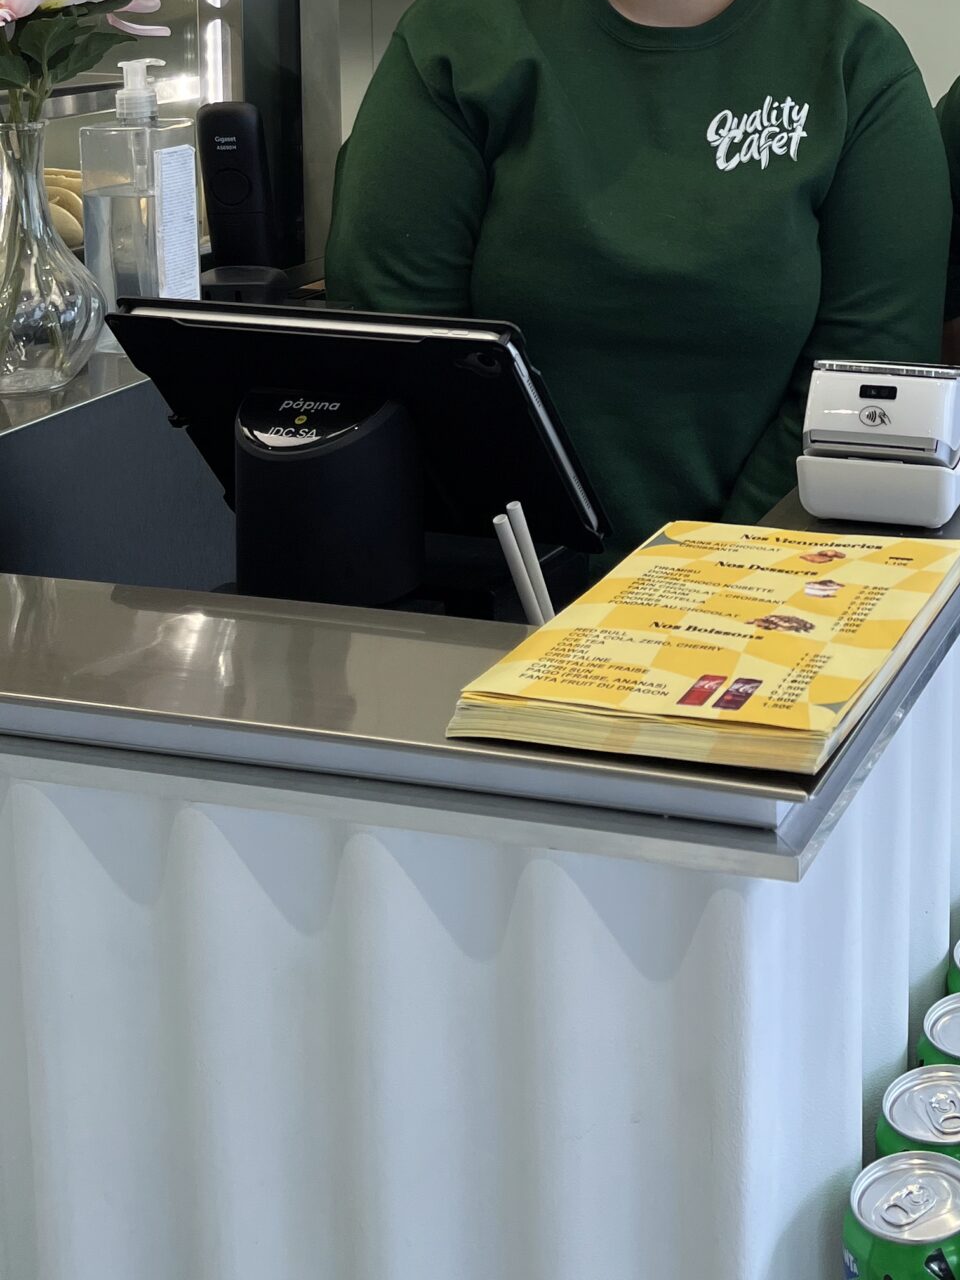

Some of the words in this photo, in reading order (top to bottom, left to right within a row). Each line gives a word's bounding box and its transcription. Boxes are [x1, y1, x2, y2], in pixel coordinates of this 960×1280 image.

[706, 96, 810, 146] Quality
[716, 123, 808, 172] Cafet
[296, 428, 317, 438] SA
[741, 533, 770, 542] Nos
[715, 560, 744, 570] Nos
[748, 563, 819, 577] Desserts
[649, 621, 681, 631] Nos
[684, 626, 764, 640] Boissons
